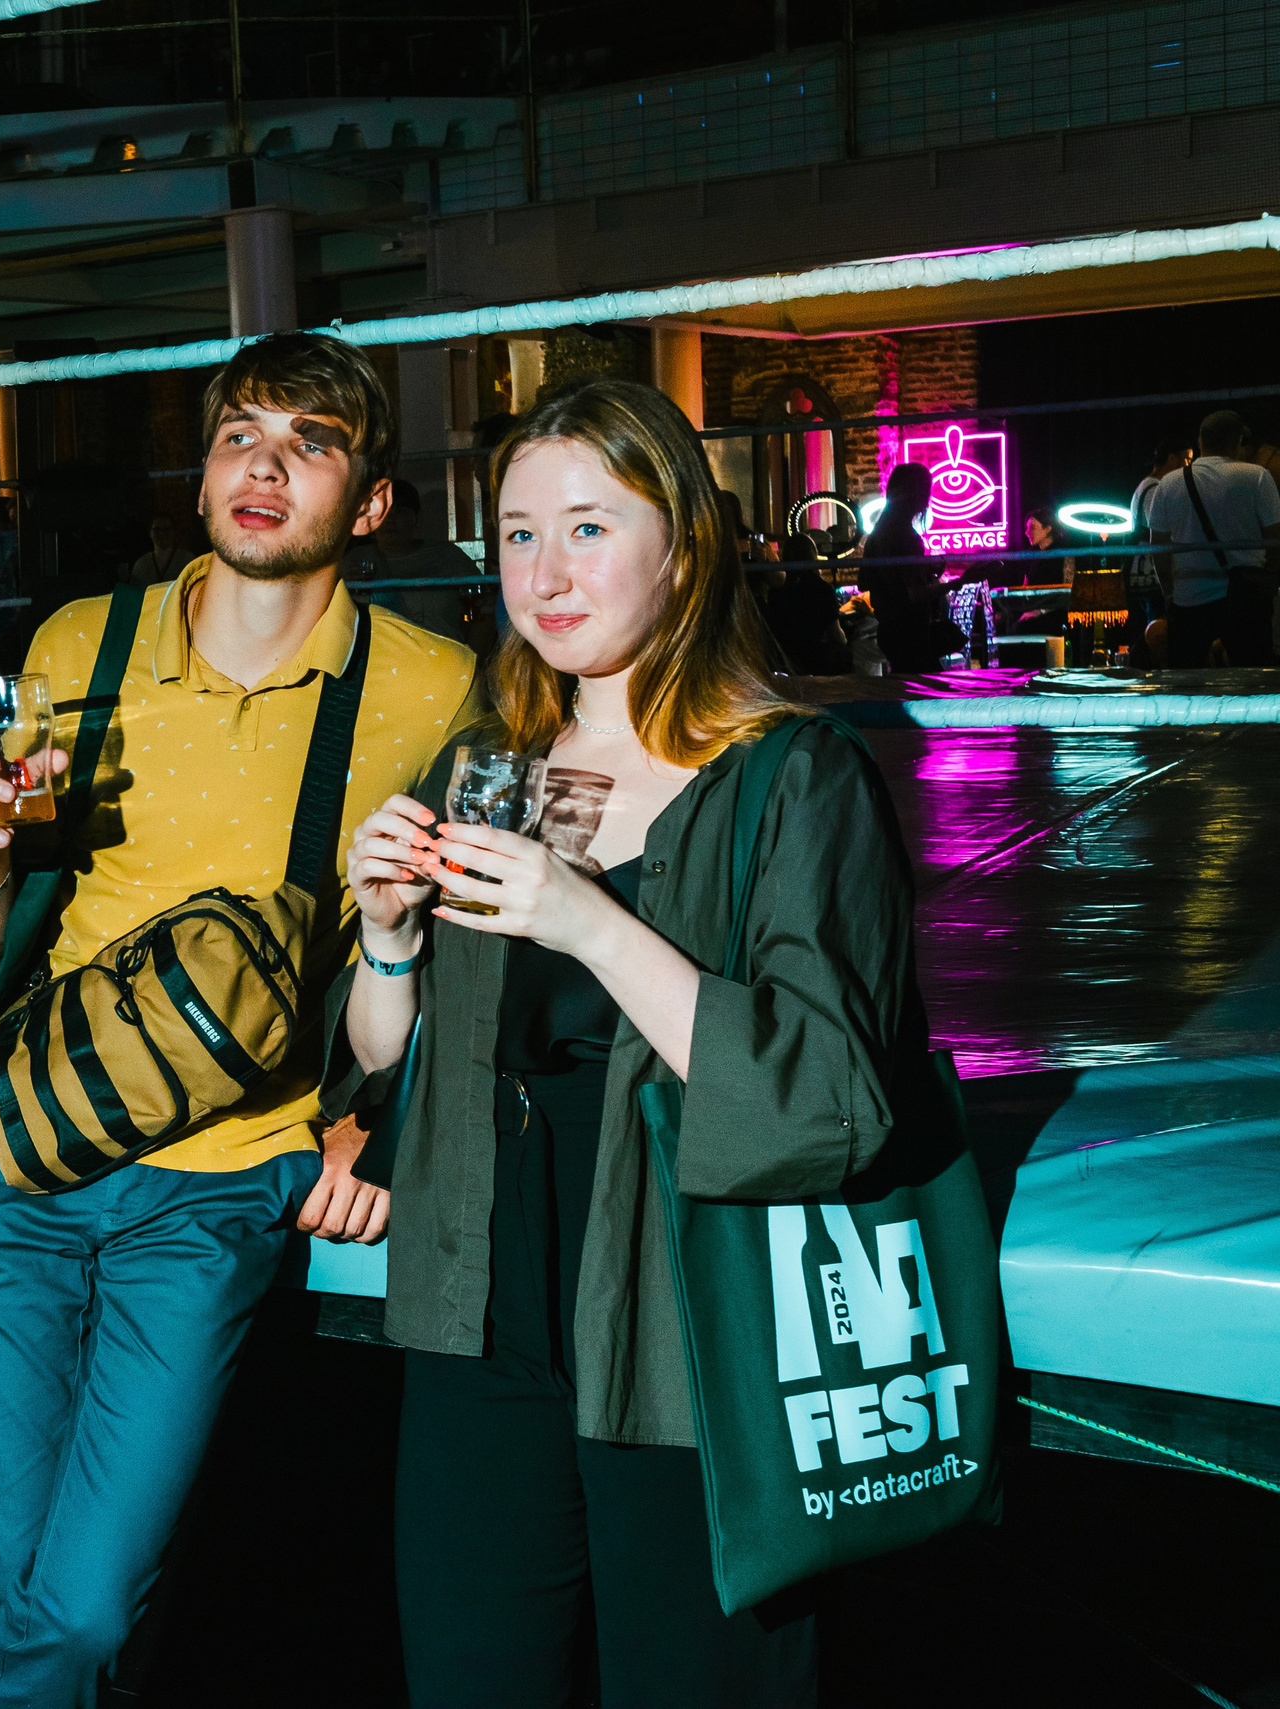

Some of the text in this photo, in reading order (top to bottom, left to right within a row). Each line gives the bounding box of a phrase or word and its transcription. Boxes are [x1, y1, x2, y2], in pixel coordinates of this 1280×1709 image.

[923, 531, 1007, 549] CKSTAGE
[185, 1001, 220, 1043] BIKKEMBERGS
[827, 1269, 853, 1336] 2024
[784, 1364, 969, 1473] FEST
[802, 1488, 834, 1519] by
